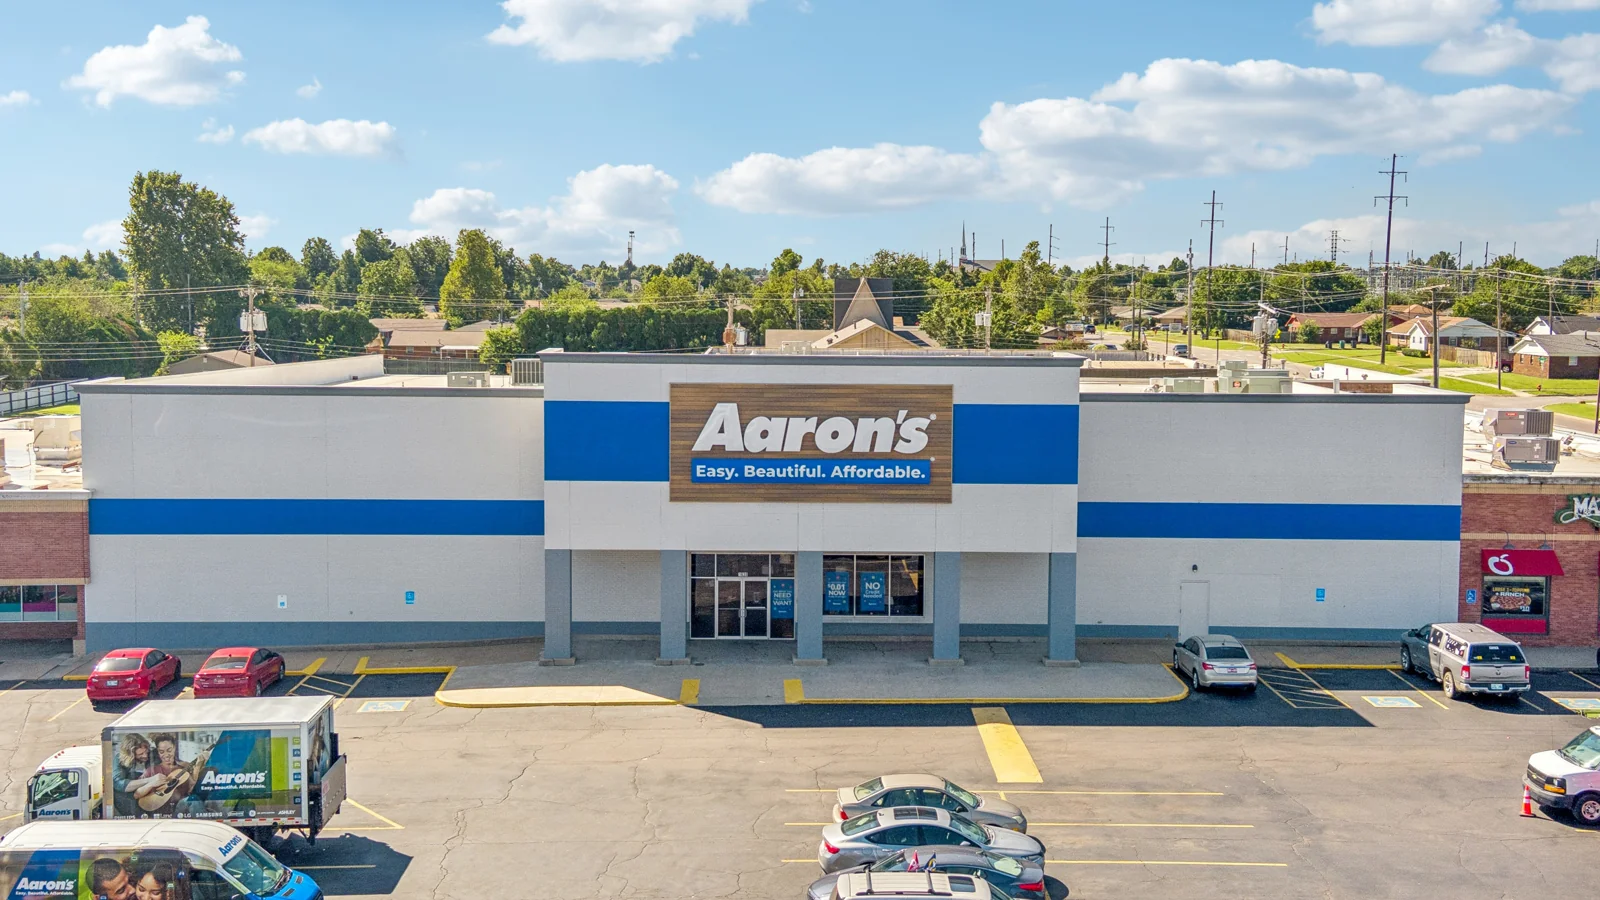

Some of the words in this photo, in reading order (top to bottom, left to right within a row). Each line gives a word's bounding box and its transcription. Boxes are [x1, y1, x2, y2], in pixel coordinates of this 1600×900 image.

[691, 402, 931, 454] Aaron's
[696, 464, 739, 478] Easy.
[744, 464, 826, 478] Beautiful.
[830, 465, 926, 479] Affordable.
[1572, 496, 1600, 519] MA
[865, 582, 881, 590] NO
[201, 770, 267, 785] Aaron's
[218, 834, 243, 857] Aaron's
[16, 878, 76, 890] Aaron's
